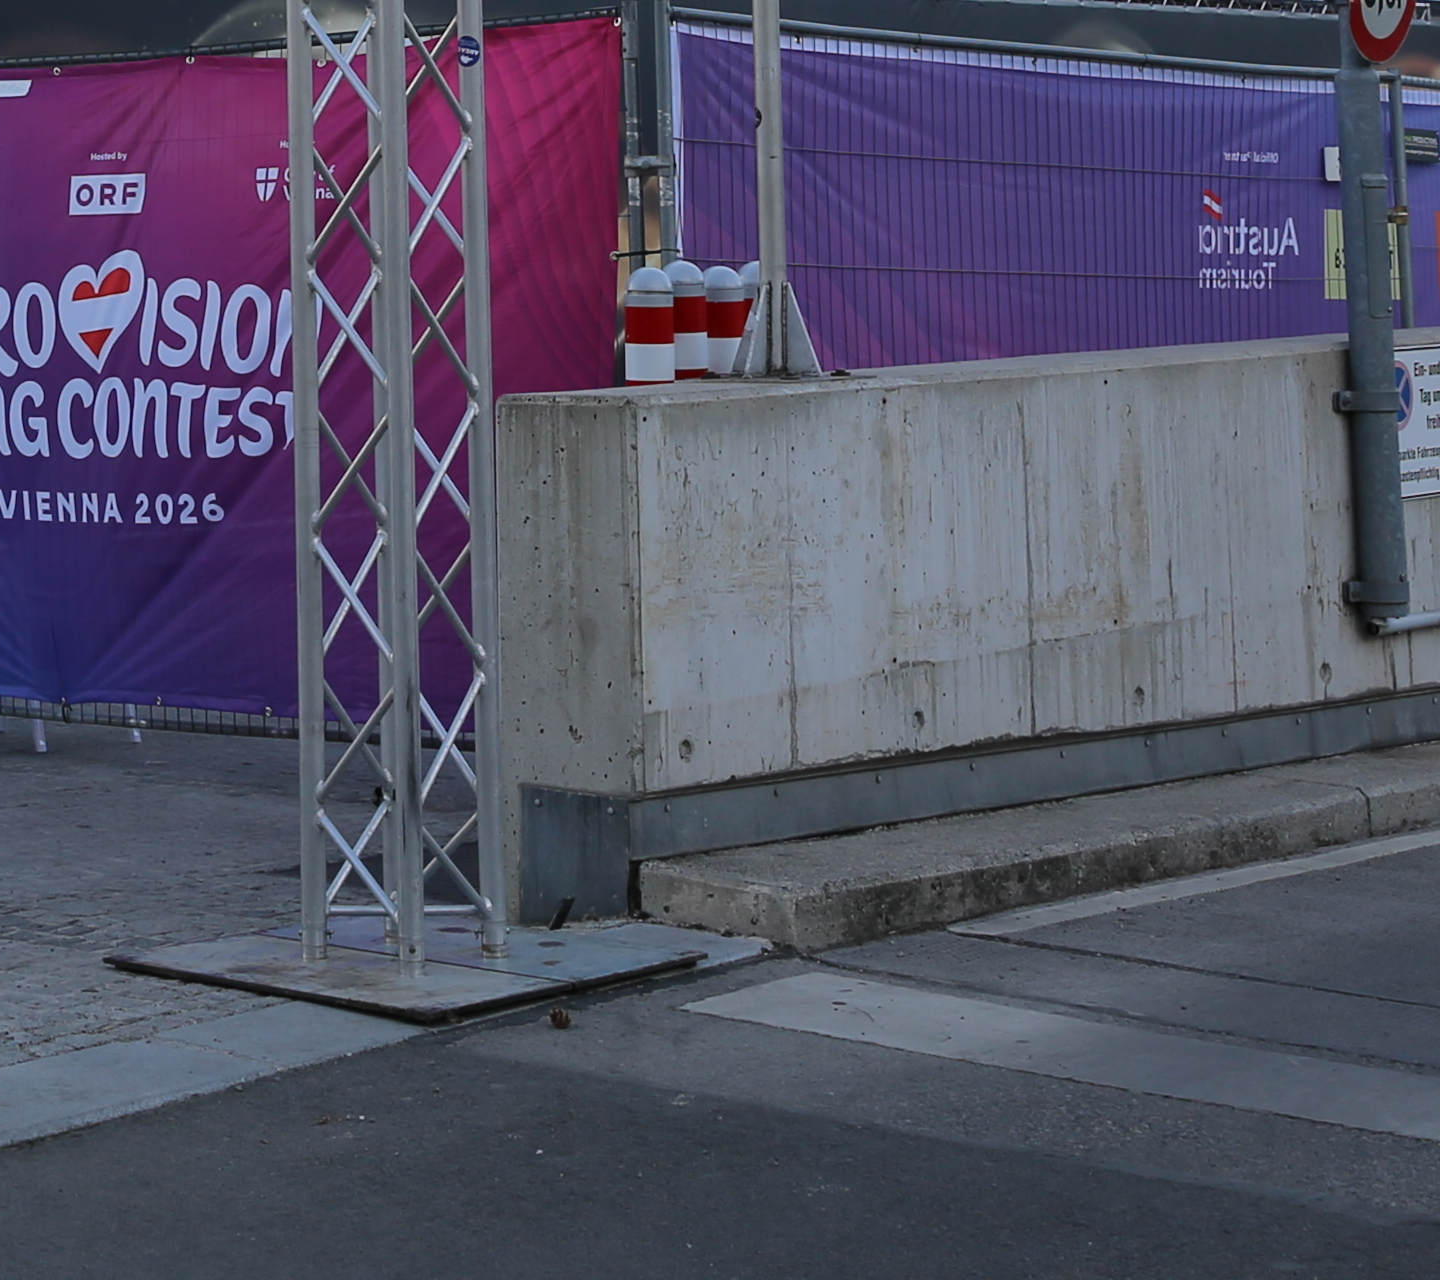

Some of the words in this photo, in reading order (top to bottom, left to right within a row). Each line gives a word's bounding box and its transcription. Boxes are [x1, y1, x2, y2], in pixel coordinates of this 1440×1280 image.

[90, 151, 117, 162] Hosted
[117, 151, 128, 162] by
[74, 181, 139, 206] ORF
[1429, 360, 1440, 376] und
[1420, 388, 1432, 407] Tag
[134, 491, 226, 526] 2026
